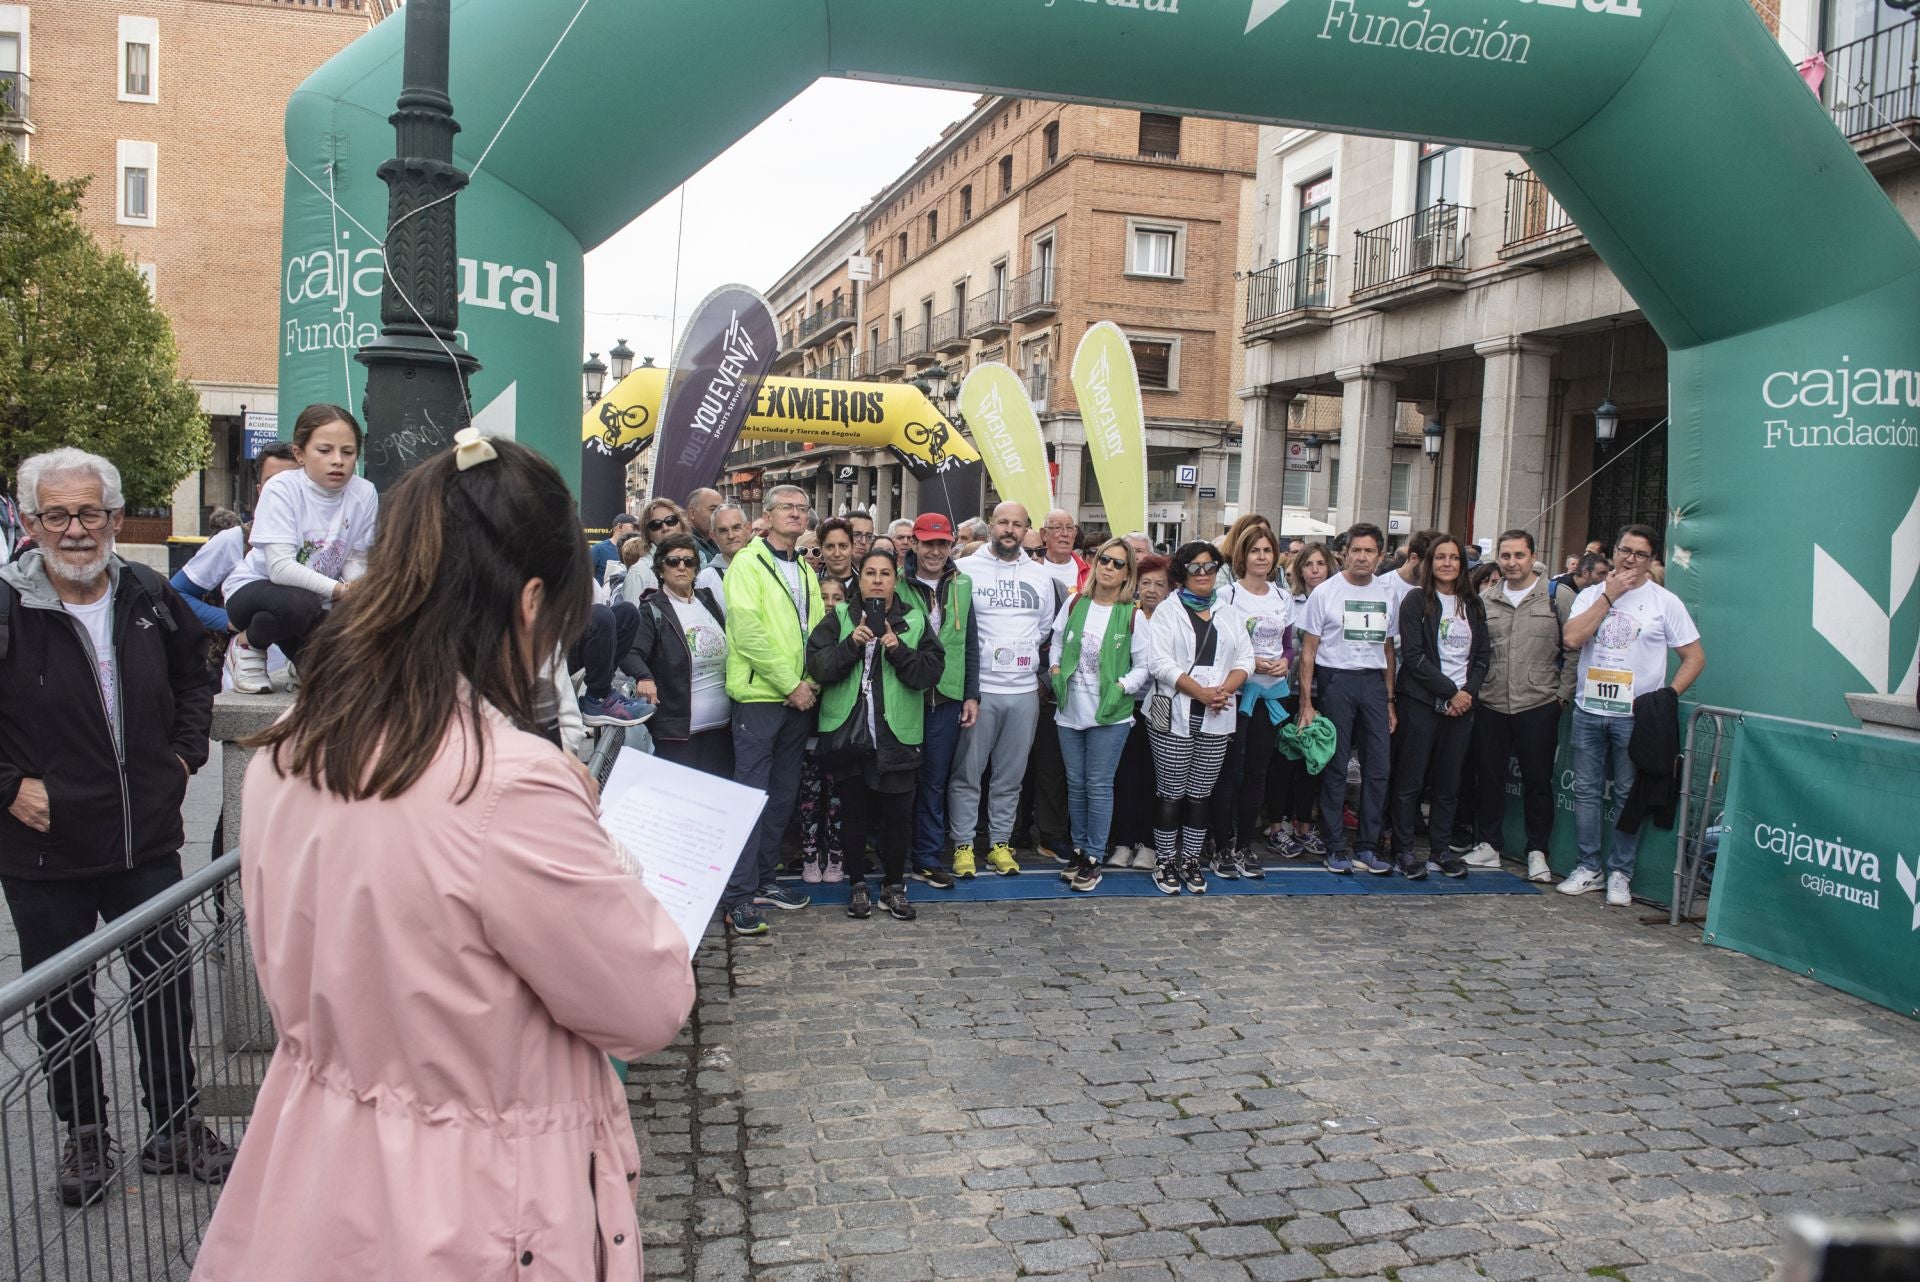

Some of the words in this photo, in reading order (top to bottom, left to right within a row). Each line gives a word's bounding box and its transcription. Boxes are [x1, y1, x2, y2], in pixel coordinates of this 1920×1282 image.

[1317, 0, 1531, 64] Fundación
[286, 231, 560, 323] cajaural
[714, 410, 731, 438] SPORTS
[728, 378, 748, 410] SERVICES
[1763, 418, 1919, 448] Fundación
[978, 588, 1020, 598] NORTH
[996, 580, 1015, 589] THE
[989, 597, 1020, 608] FACE
[1364, 614, 1369, 628] 1
[1597, 683, 1619, 698] 1117
[1755, 823, 1881, 883] cajaviva
[1801, 874, 1880, 909] cajarural
